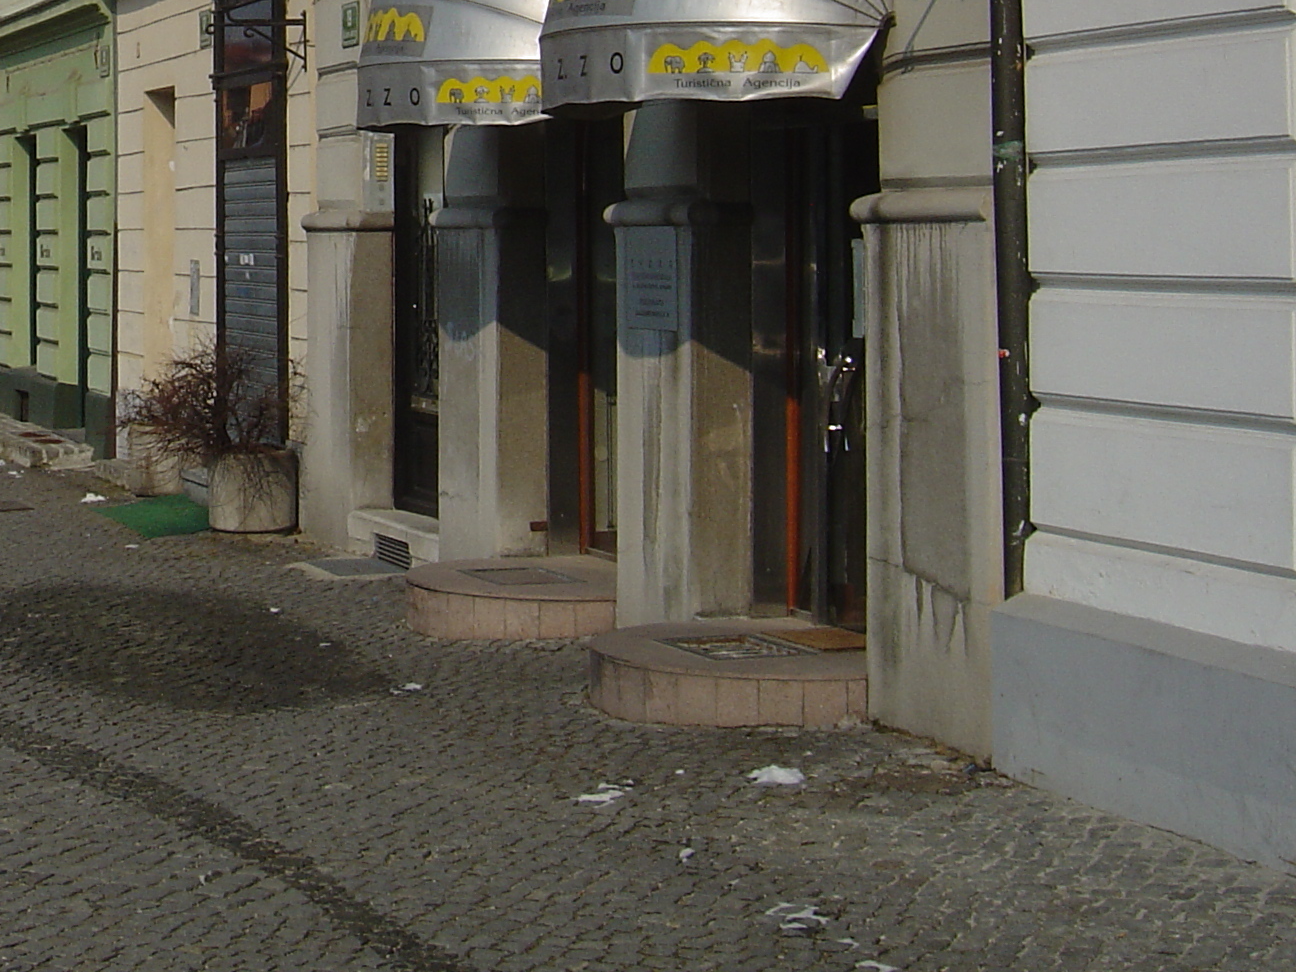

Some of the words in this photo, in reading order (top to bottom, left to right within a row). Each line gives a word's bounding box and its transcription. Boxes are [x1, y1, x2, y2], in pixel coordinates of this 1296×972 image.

[674, 78, 732, 88] Turistična
[742, 77, 801, 89] Agencija
[511, 107, 542, 117] Agen
